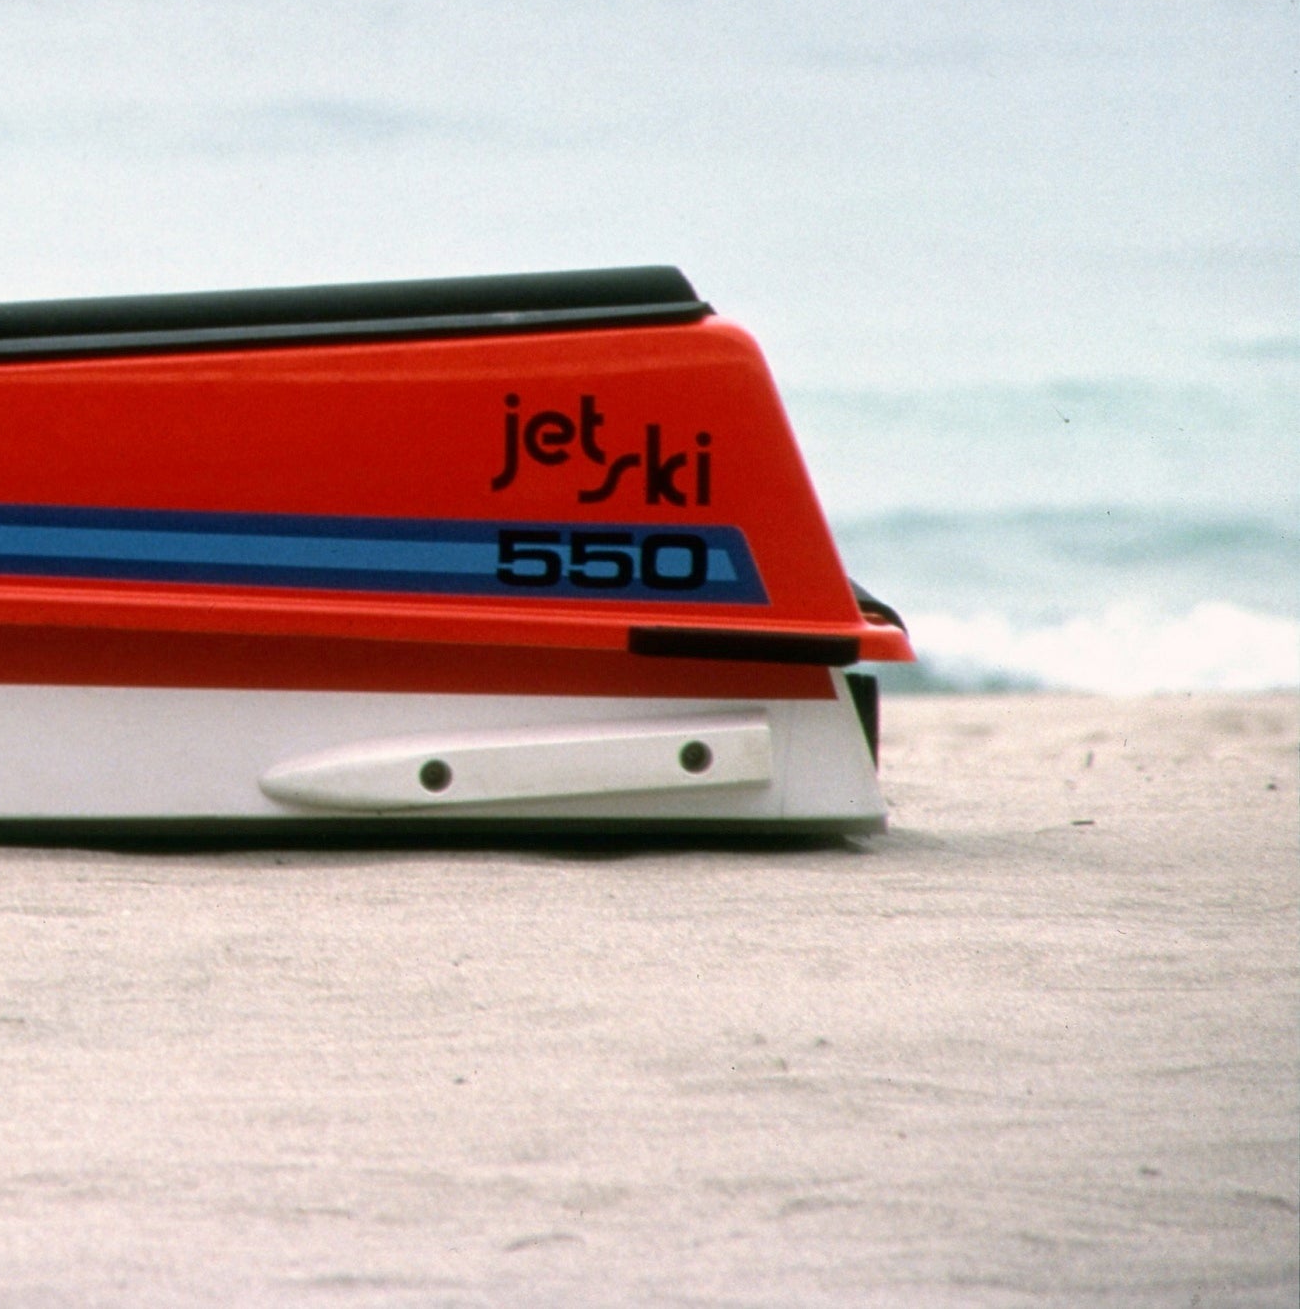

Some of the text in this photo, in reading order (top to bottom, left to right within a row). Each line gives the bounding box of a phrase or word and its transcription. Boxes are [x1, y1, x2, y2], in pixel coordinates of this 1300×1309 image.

[491, 393, 712, 507] jet ski
[496, 530, 708, 591] 550
